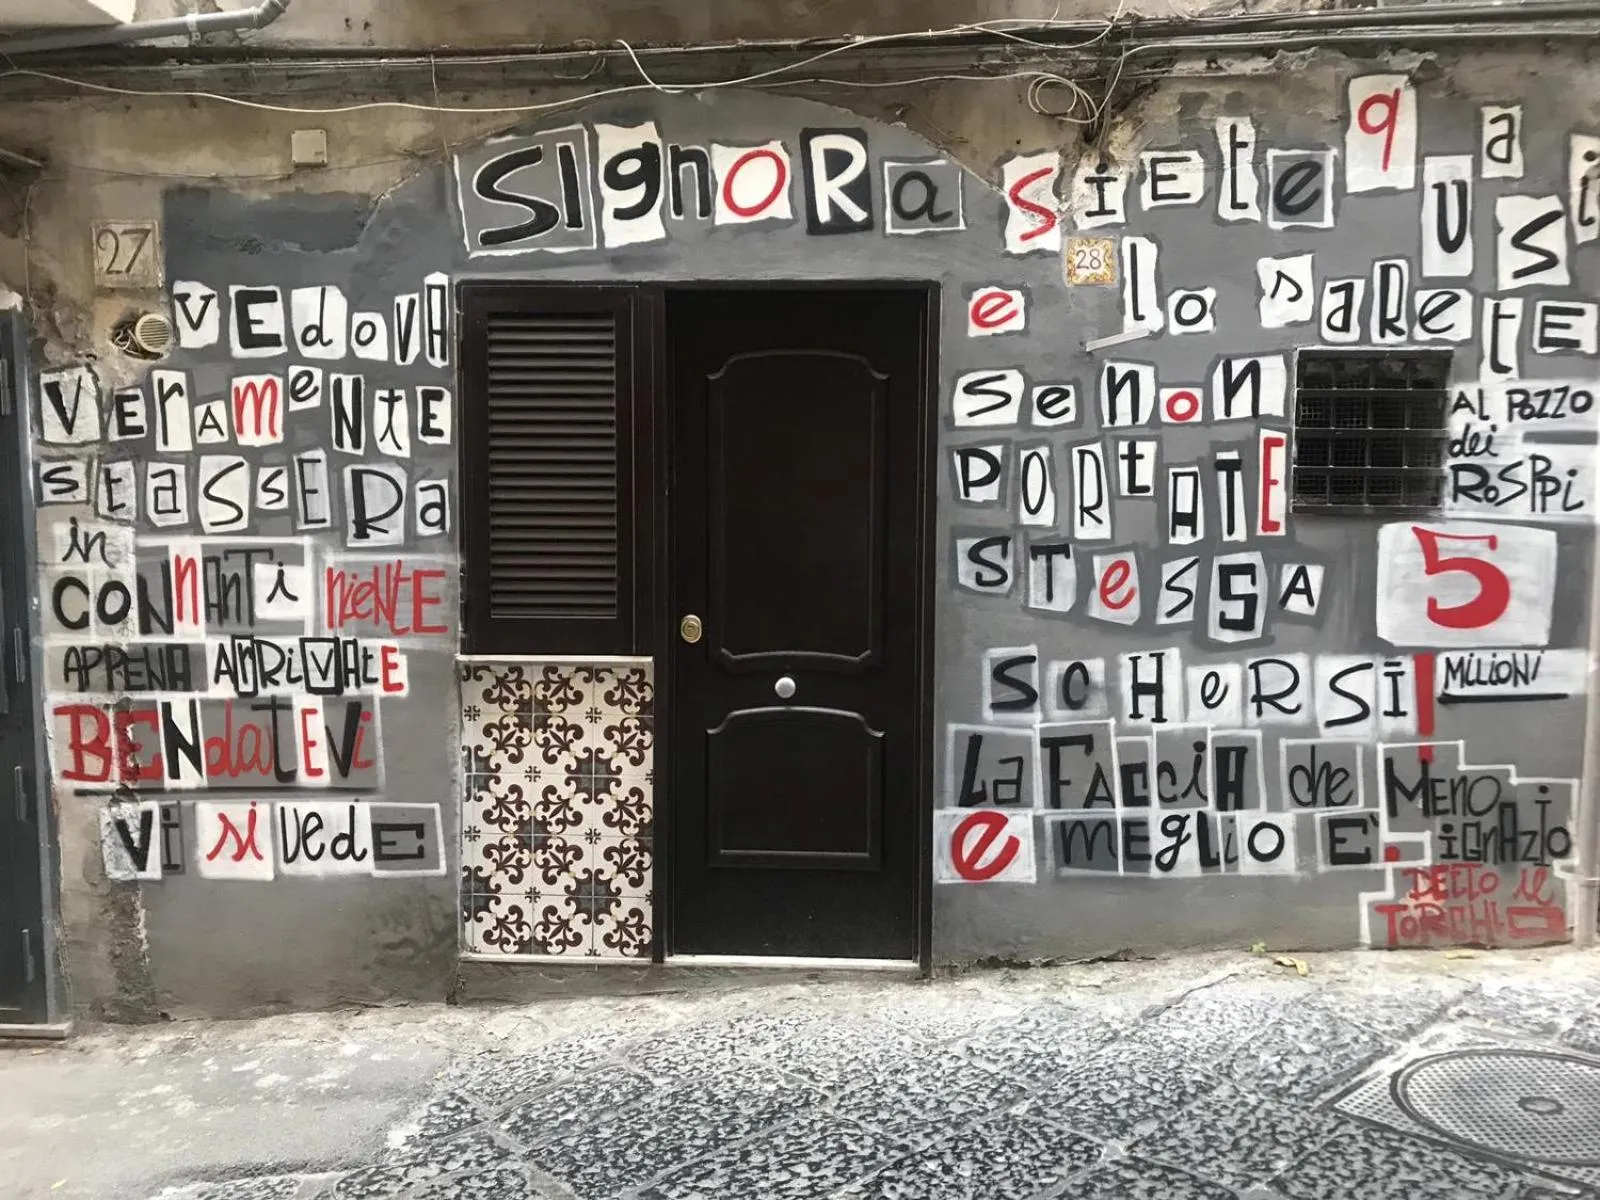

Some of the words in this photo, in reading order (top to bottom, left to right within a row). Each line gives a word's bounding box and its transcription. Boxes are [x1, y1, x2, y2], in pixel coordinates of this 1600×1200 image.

[97, 228, 151, 274] 27
[1076, 249, 1101, 270] 28
[970, 291, 1018, 329] e
[1452, 389, 1489, 420] AL
[1449, 423, 1498, 458] dei
[62, 516, 115, 568] in
[1411, 526, 1510, 628] 5
[1289, 744, 1354, 807] che
[951, 811, 1021, 882] e
